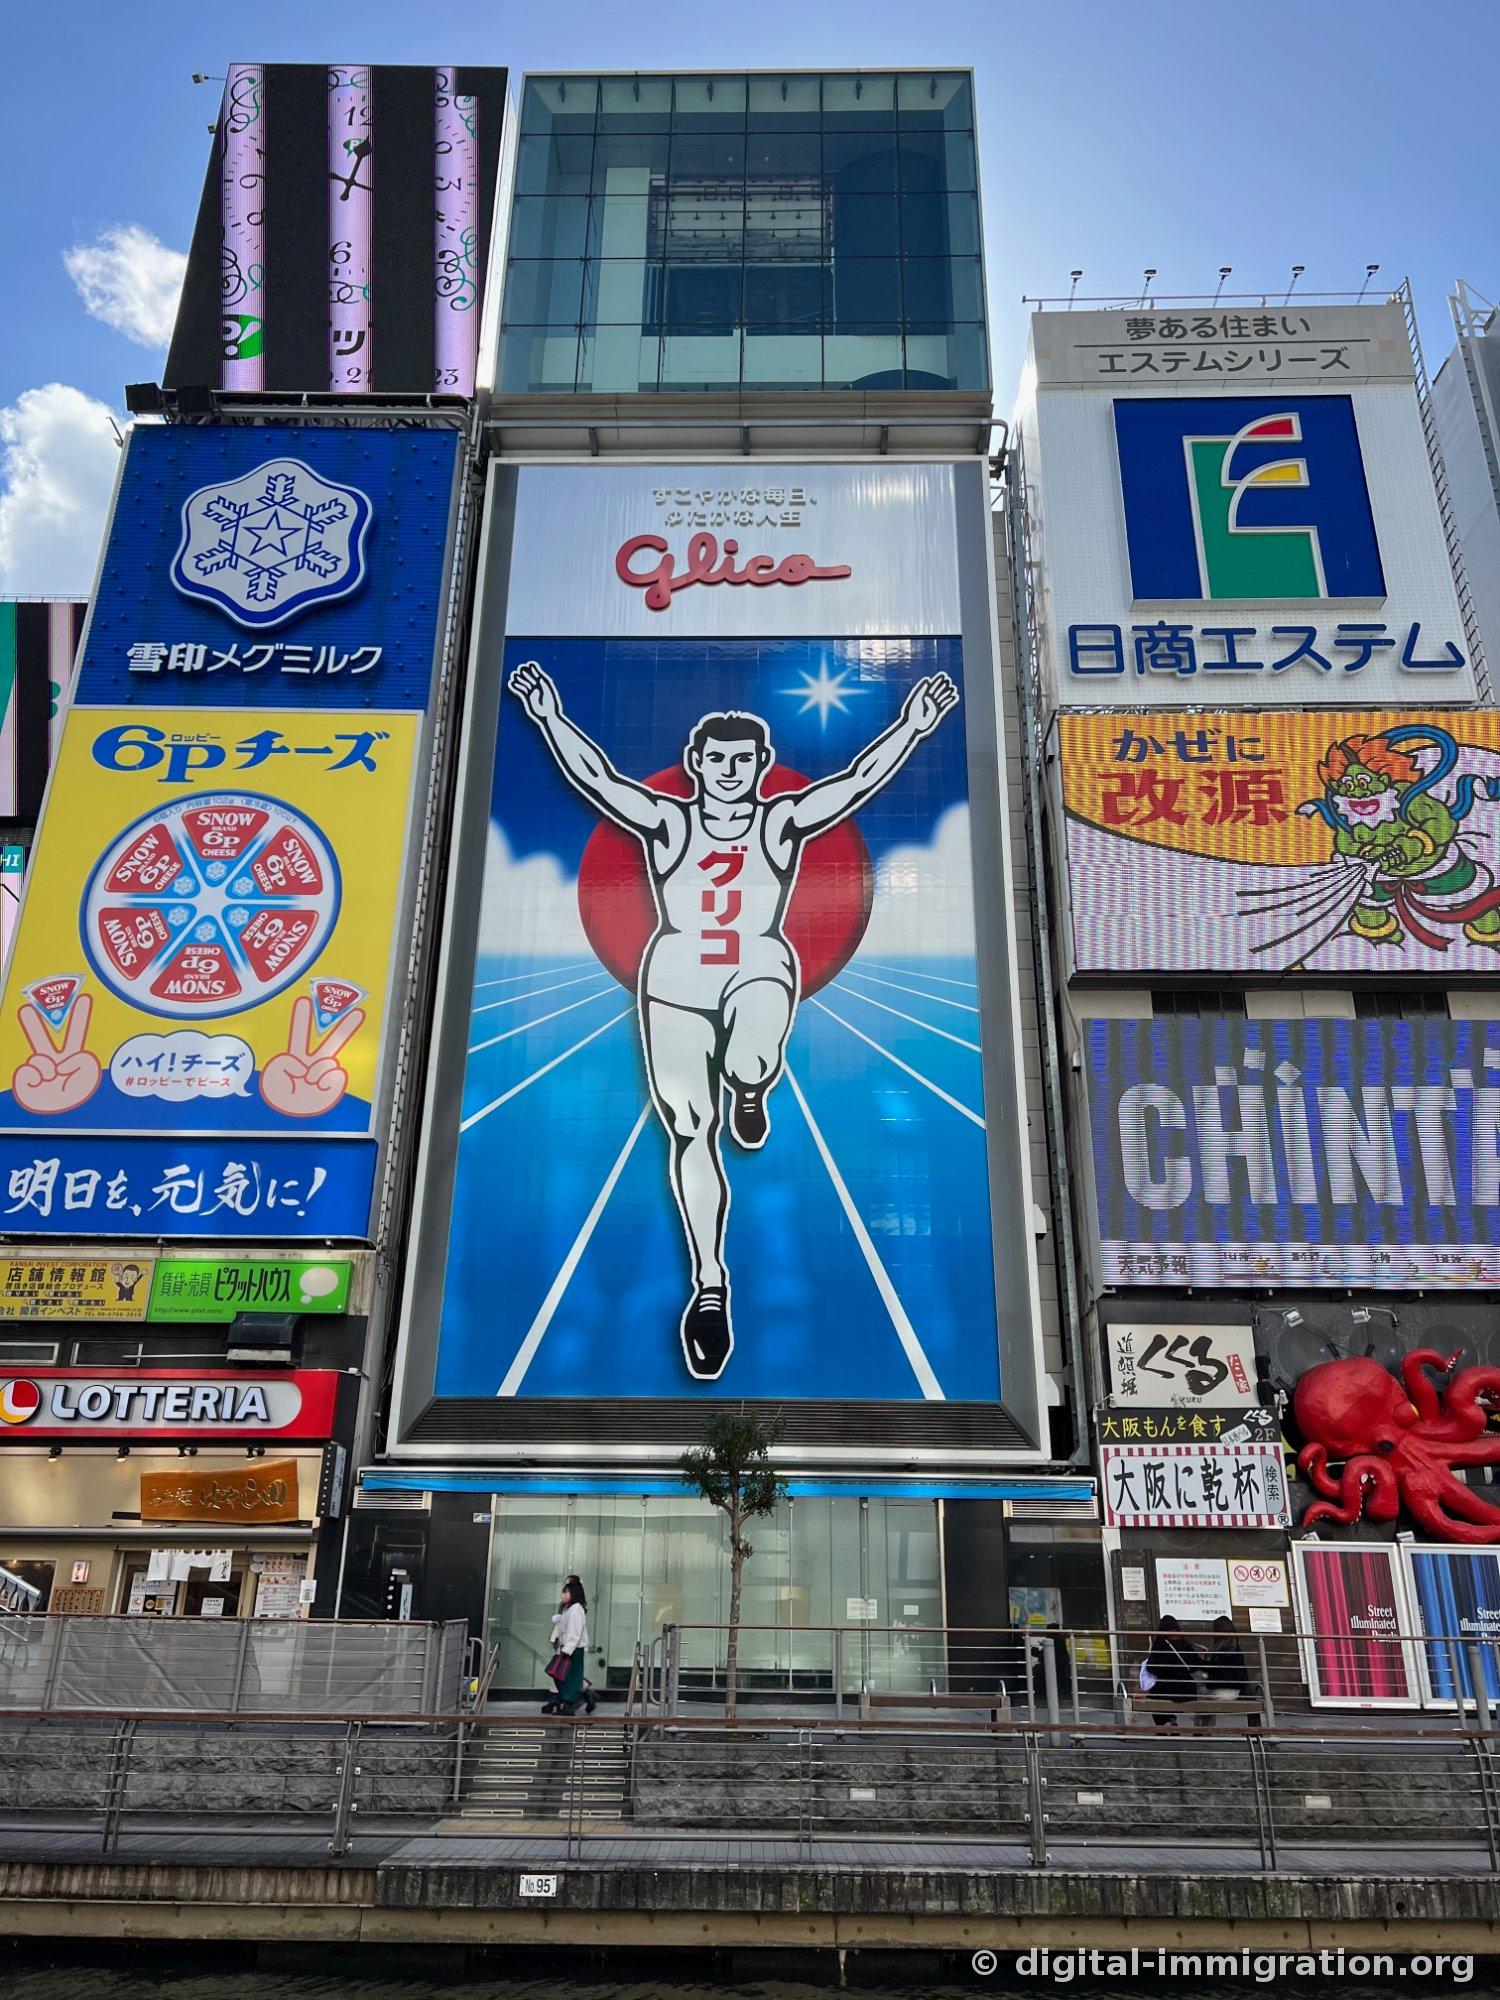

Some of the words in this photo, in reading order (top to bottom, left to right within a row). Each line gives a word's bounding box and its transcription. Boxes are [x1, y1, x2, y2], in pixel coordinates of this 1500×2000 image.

[1125, 315, 1311, 341] 夢ある住まい
[1099, 346, 1350, 373] エステムシリーズ
[615, 532, 852, 611] Glico
[126, 642, 383, 674] 雪印メグミルク
[1068, 620, 1466, 676] 日商エステム
[1112, 728, 1265, 763] かぜに
[1097, 768, 1288, 827] 改源
[197, 813, 255, 826] SNOW
[115, 834, 160, 882] SNOW
[202, 849, 237, 857] CHEESE
[282, 838, 317, 884] SNOW
[155, 862, 182, 890] CHEESE
[253, 863, 273, 892] CHEESE
[697, 845, 748, 965] グリコ
[149, 911, 168, 940] CHEESE
[242, 913, 268, 942] CHEESE
[104, 918, 137, 967] SNOW
[185, 947, 220, 955] CHEESE
[265, 920, 308, 972] SNOW
[40, 982, 70, 995] SNOW
[164, 980, 225, 994] SNOW
[323, 985, 352, 998] SNOW
[7, 1267, 107, 1283] 店舗情報館
[214, 1267, 291, 1302] ピタットハウス
[1117, 1332, 1138, 1396] 道頓堀
[1136, 1334, 1229, 1396] くくる
[51, 1384, 270, 1421] LOTTERIA
[1102, 1414, 1226, 1438] 大阪もんを食す
[1254, 1428, 1276, 1441] 2F
[1114, 1457, 1259, 1513] 大阪に乾杯
[1265, 1465, 1280, 1501] 検索
[1351, 1615, 1397, 1630] Illuminated
[1368, 1604, 1393, 1617] Street
